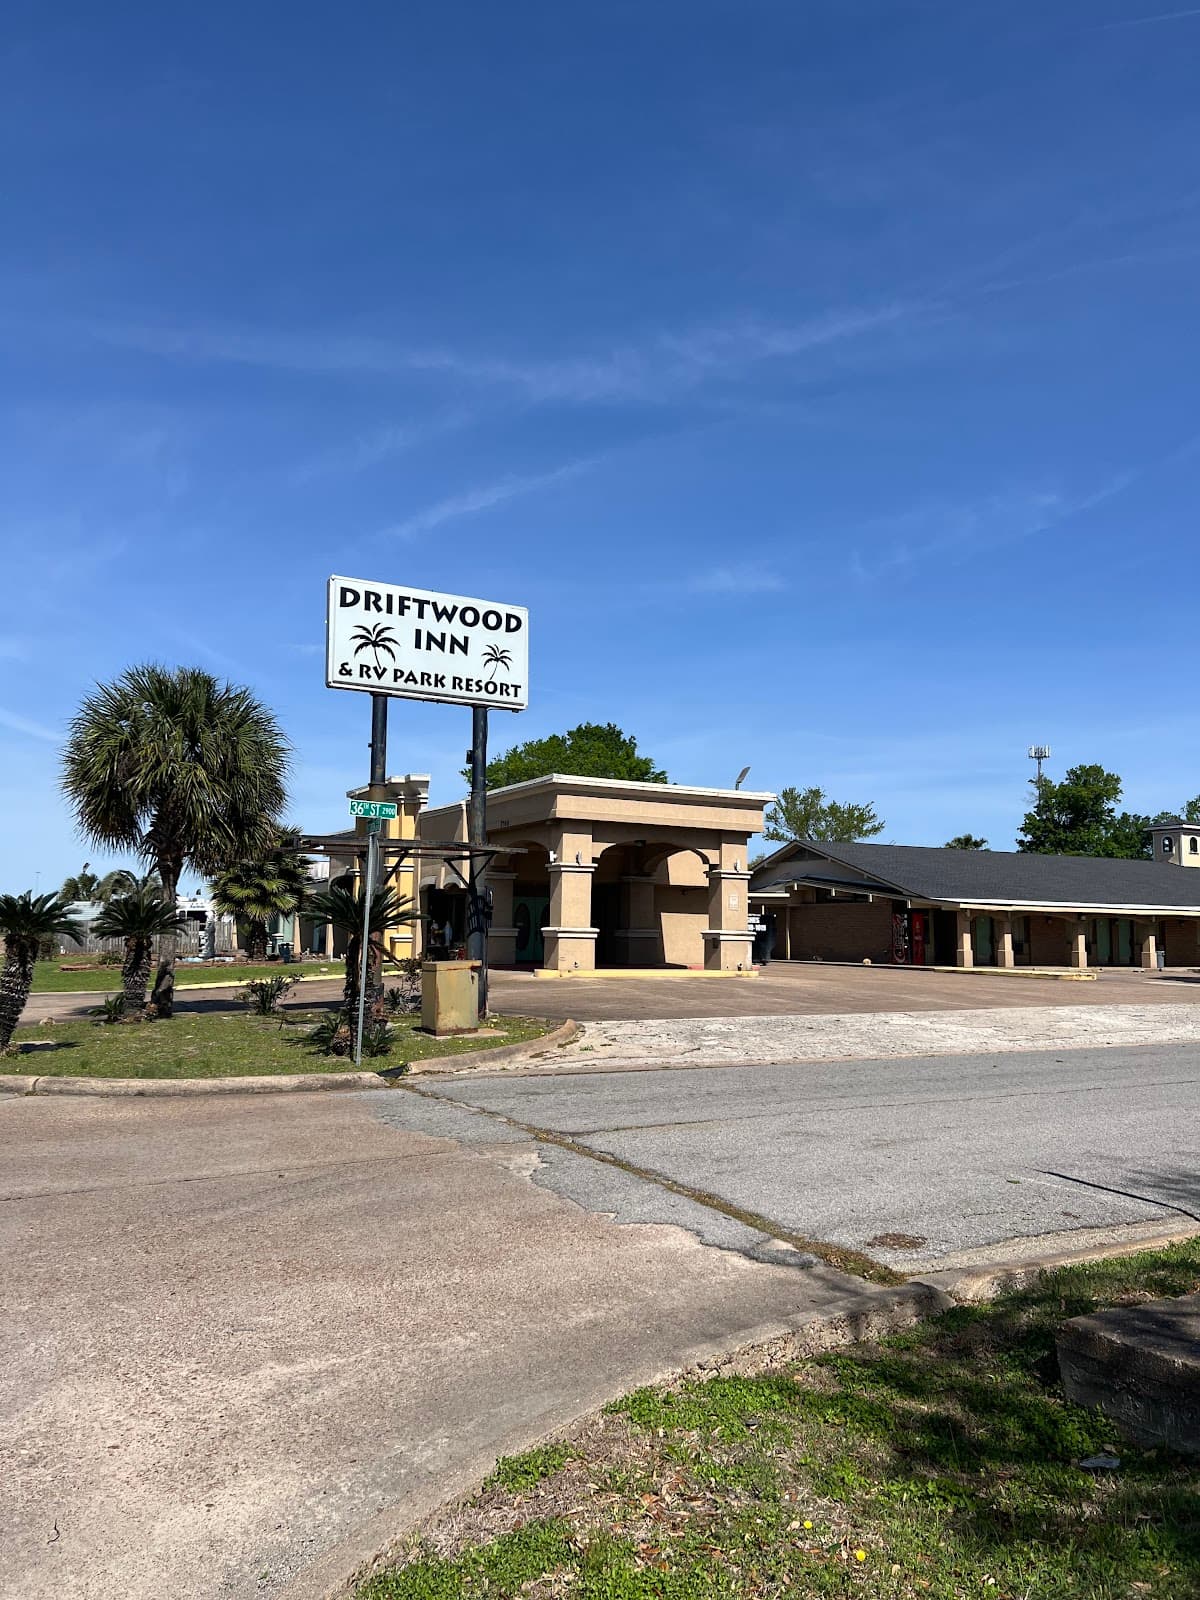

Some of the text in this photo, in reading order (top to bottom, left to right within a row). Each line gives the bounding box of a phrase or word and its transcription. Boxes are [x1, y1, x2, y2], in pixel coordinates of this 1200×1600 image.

[340, 587, 522, 633] DRIFTWOOD
[414, 628, 469, 656] INN
[338, 662, 521, 697] & RV PARK RESORT
[370, 803, 380, 816] ST
[382, 807, 395, 815] 2900
